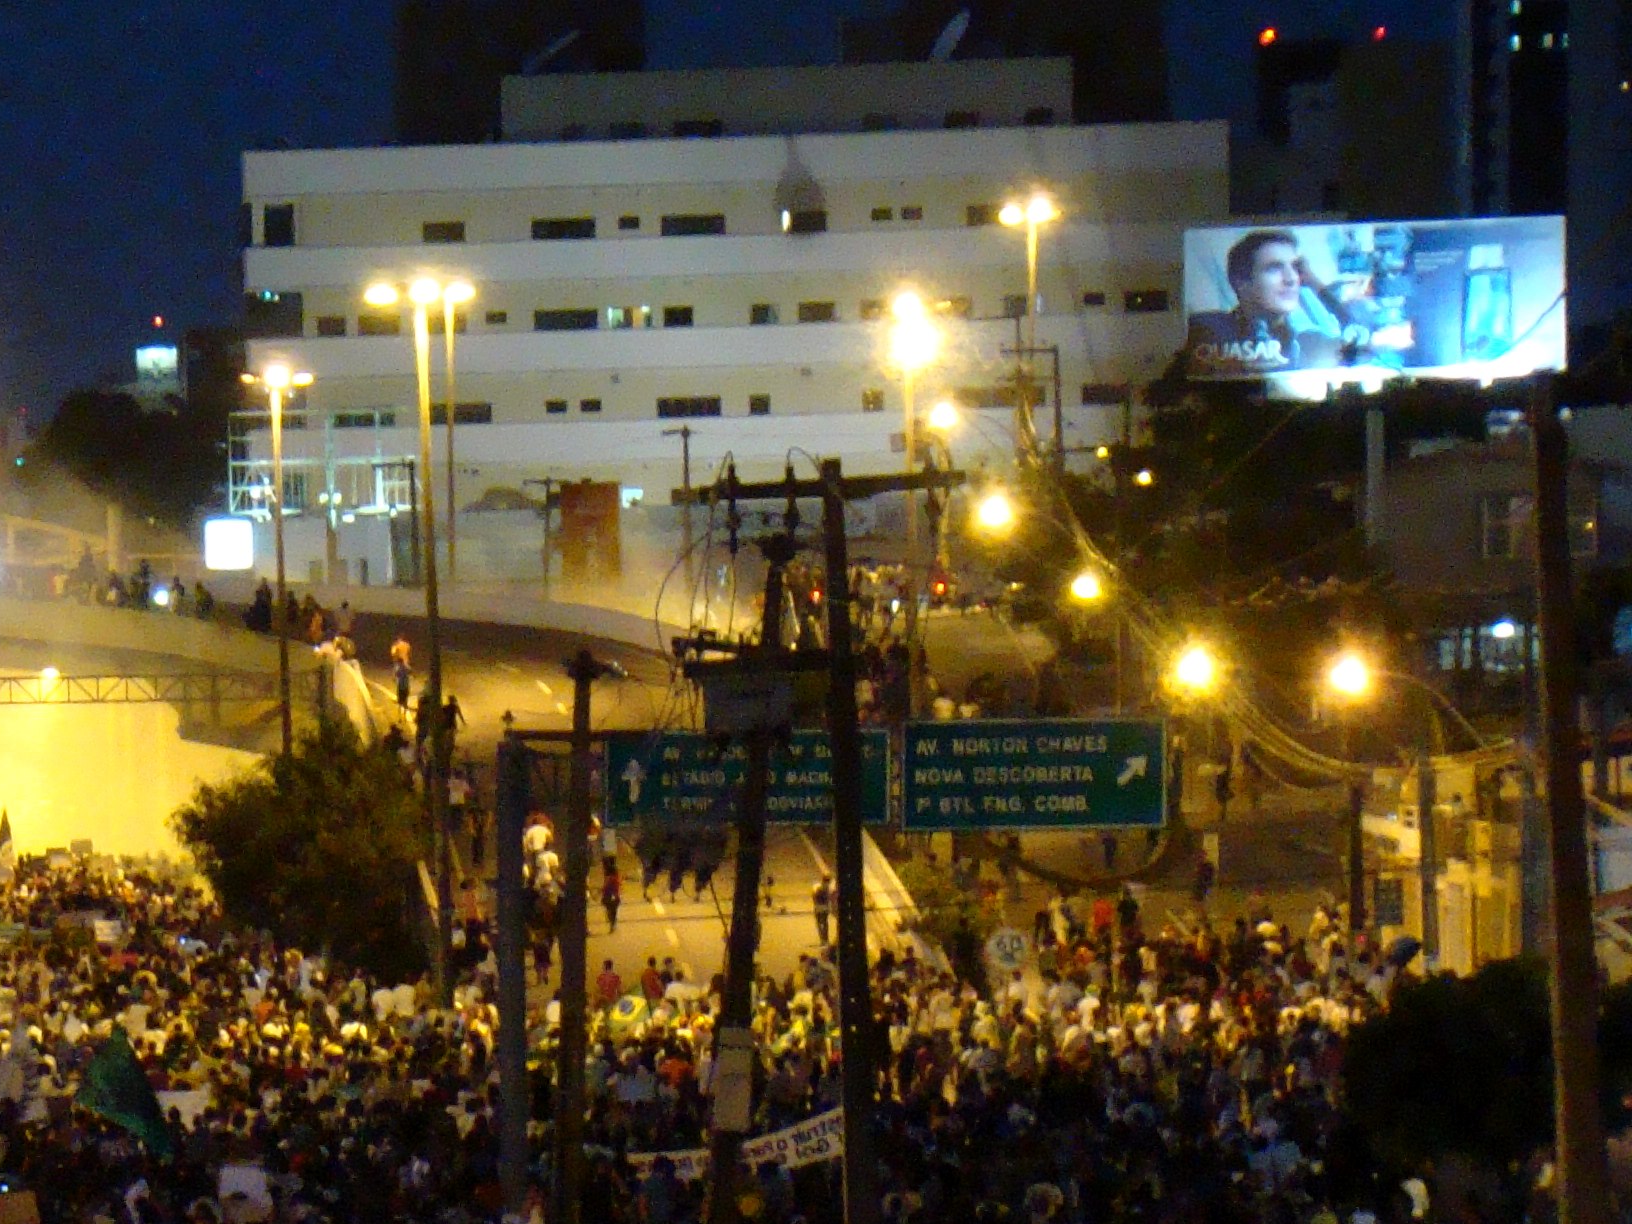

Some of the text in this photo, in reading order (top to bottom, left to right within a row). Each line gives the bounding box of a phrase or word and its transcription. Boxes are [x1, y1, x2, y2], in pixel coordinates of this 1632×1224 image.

[1195, 340, 1289, 364] QUASAR
[952, 738, 1028, 755] NORTON
[1036, 736, 1108, 752] CHAVES
[915, 766, 1094, 785] NOVA DESCOBERTA
